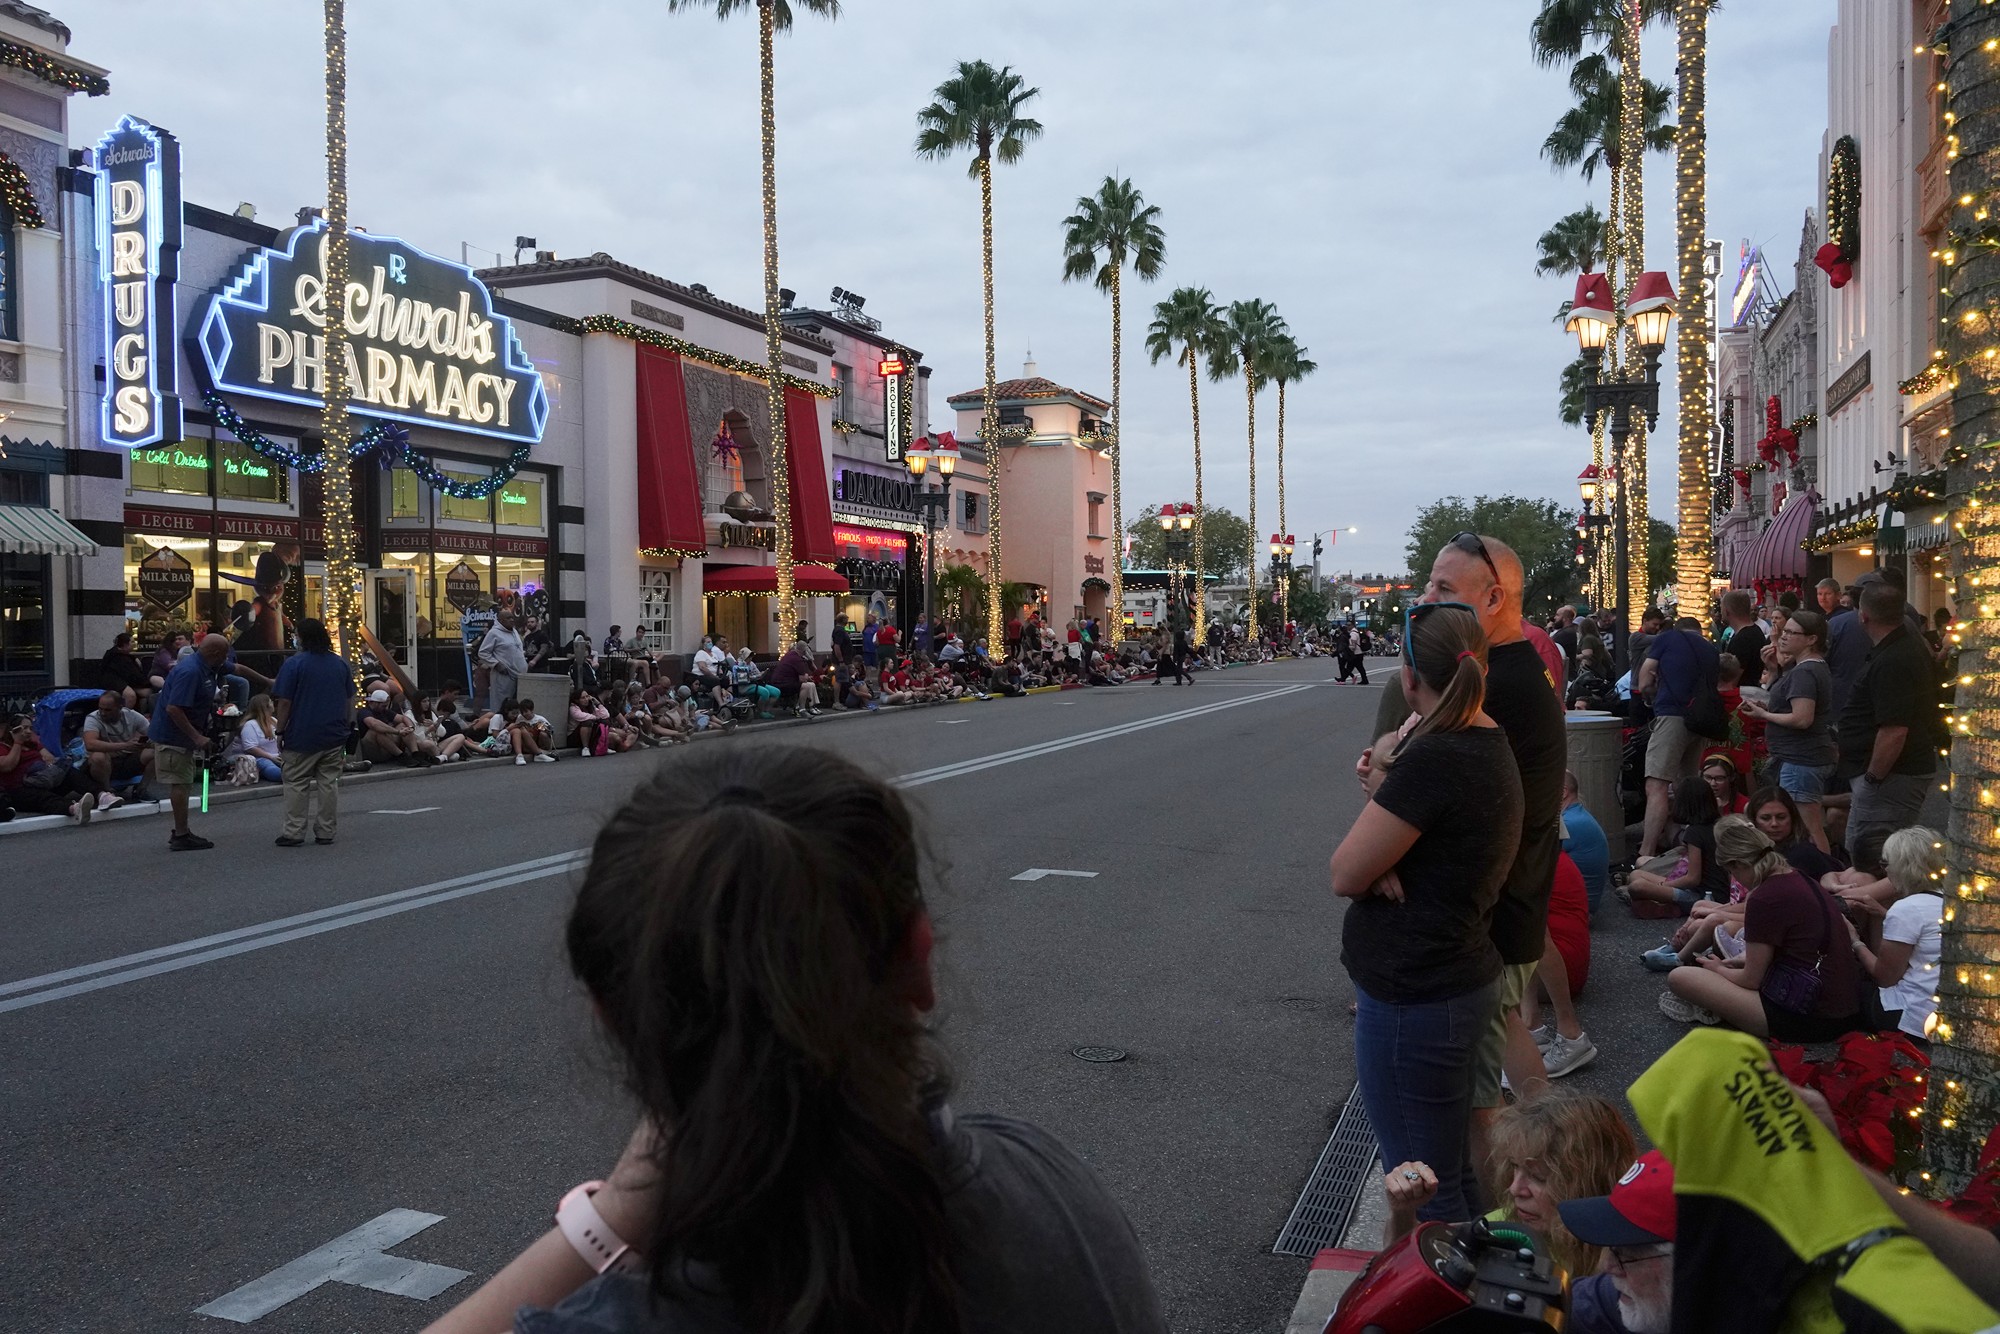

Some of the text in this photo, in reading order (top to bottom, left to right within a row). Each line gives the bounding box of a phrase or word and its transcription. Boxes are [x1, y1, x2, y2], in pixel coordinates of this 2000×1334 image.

[105, 143, 154, 166] Schwab's
[110, 180, 149, 434] DRUGS
[146, 450, 170, 465] Cold
[174, 451, 208, 468] Drinks
[224, 459, 269, 478] Ice Cream
[847, 472, 914, 511] DARKROO
[142, 514, 194, 530] LECHE
[225, 520, 292, 537] MILK BAR
[384, 536, 429, 546] LECHE
[440, 536, 489, 550] MILK BAR
[837, 532, 861, 542] FAMOUS
[865, 535, 881, 545] PHOTO
[507, 541, 538, 553] LECHE
[142, 572, 192, 583] MILK BAR
[447, 581, 480, 591] MILK BAR
[1724, 1070, 1788, 1157] ALWAYS
